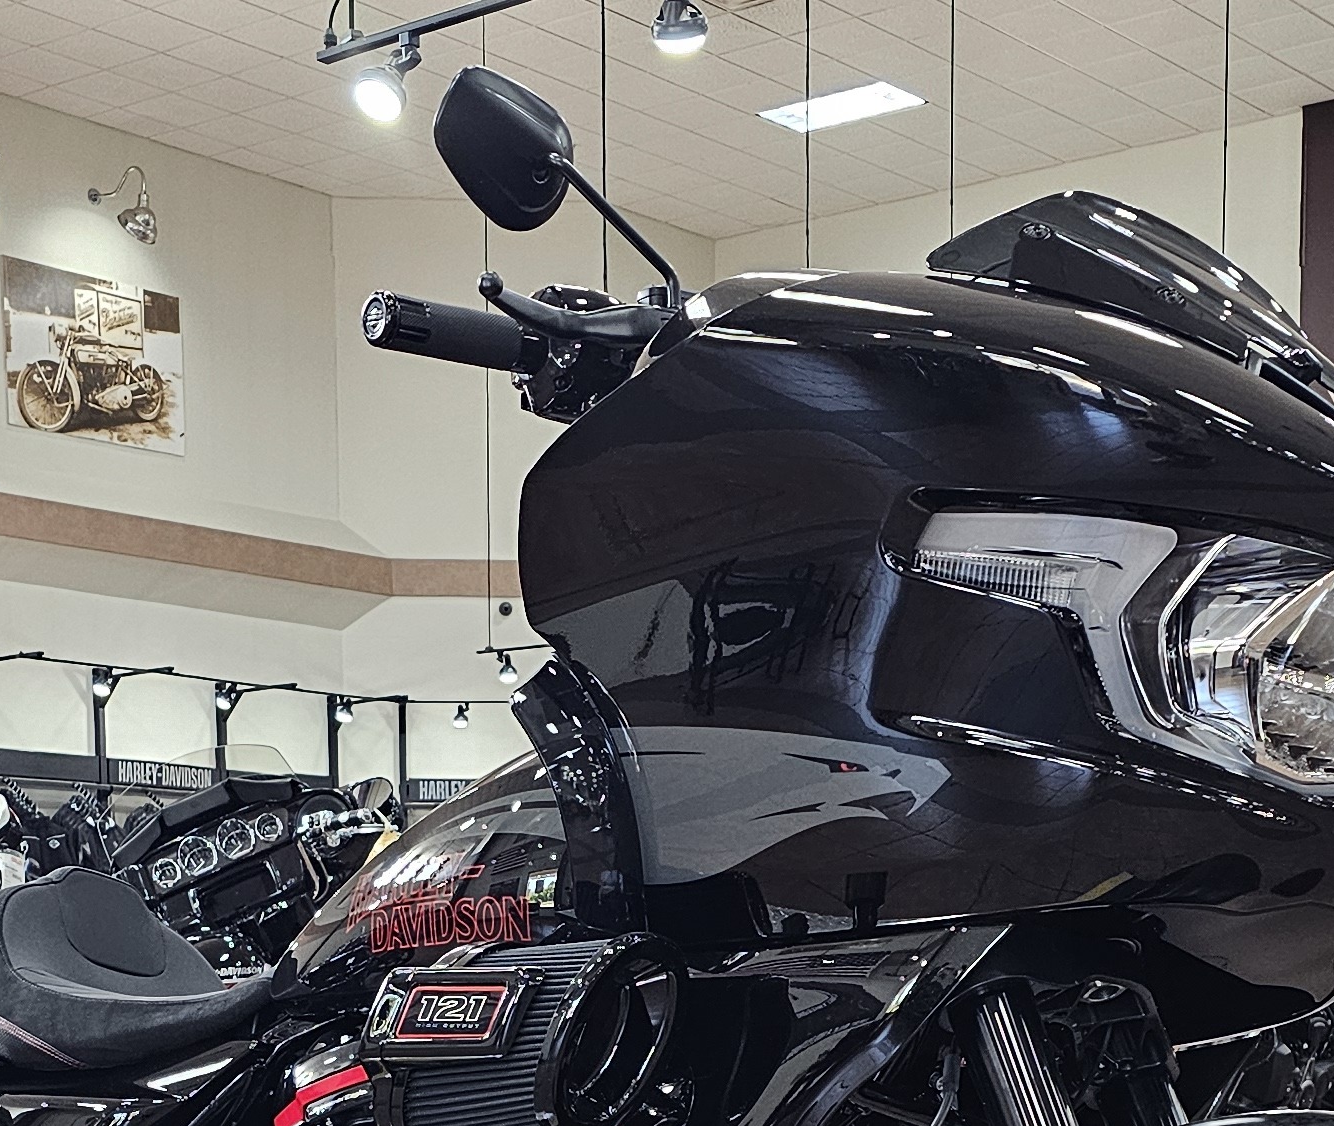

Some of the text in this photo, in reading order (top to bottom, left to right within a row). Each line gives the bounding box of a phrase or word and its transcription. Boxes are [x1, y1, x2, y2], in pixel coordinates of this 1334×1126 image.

[118, 760, 213, 788] HARLEY-DAVIDSON
[369, 895, 532, 954] DAVIDSON
[417, 995, 487, 1022] 121
